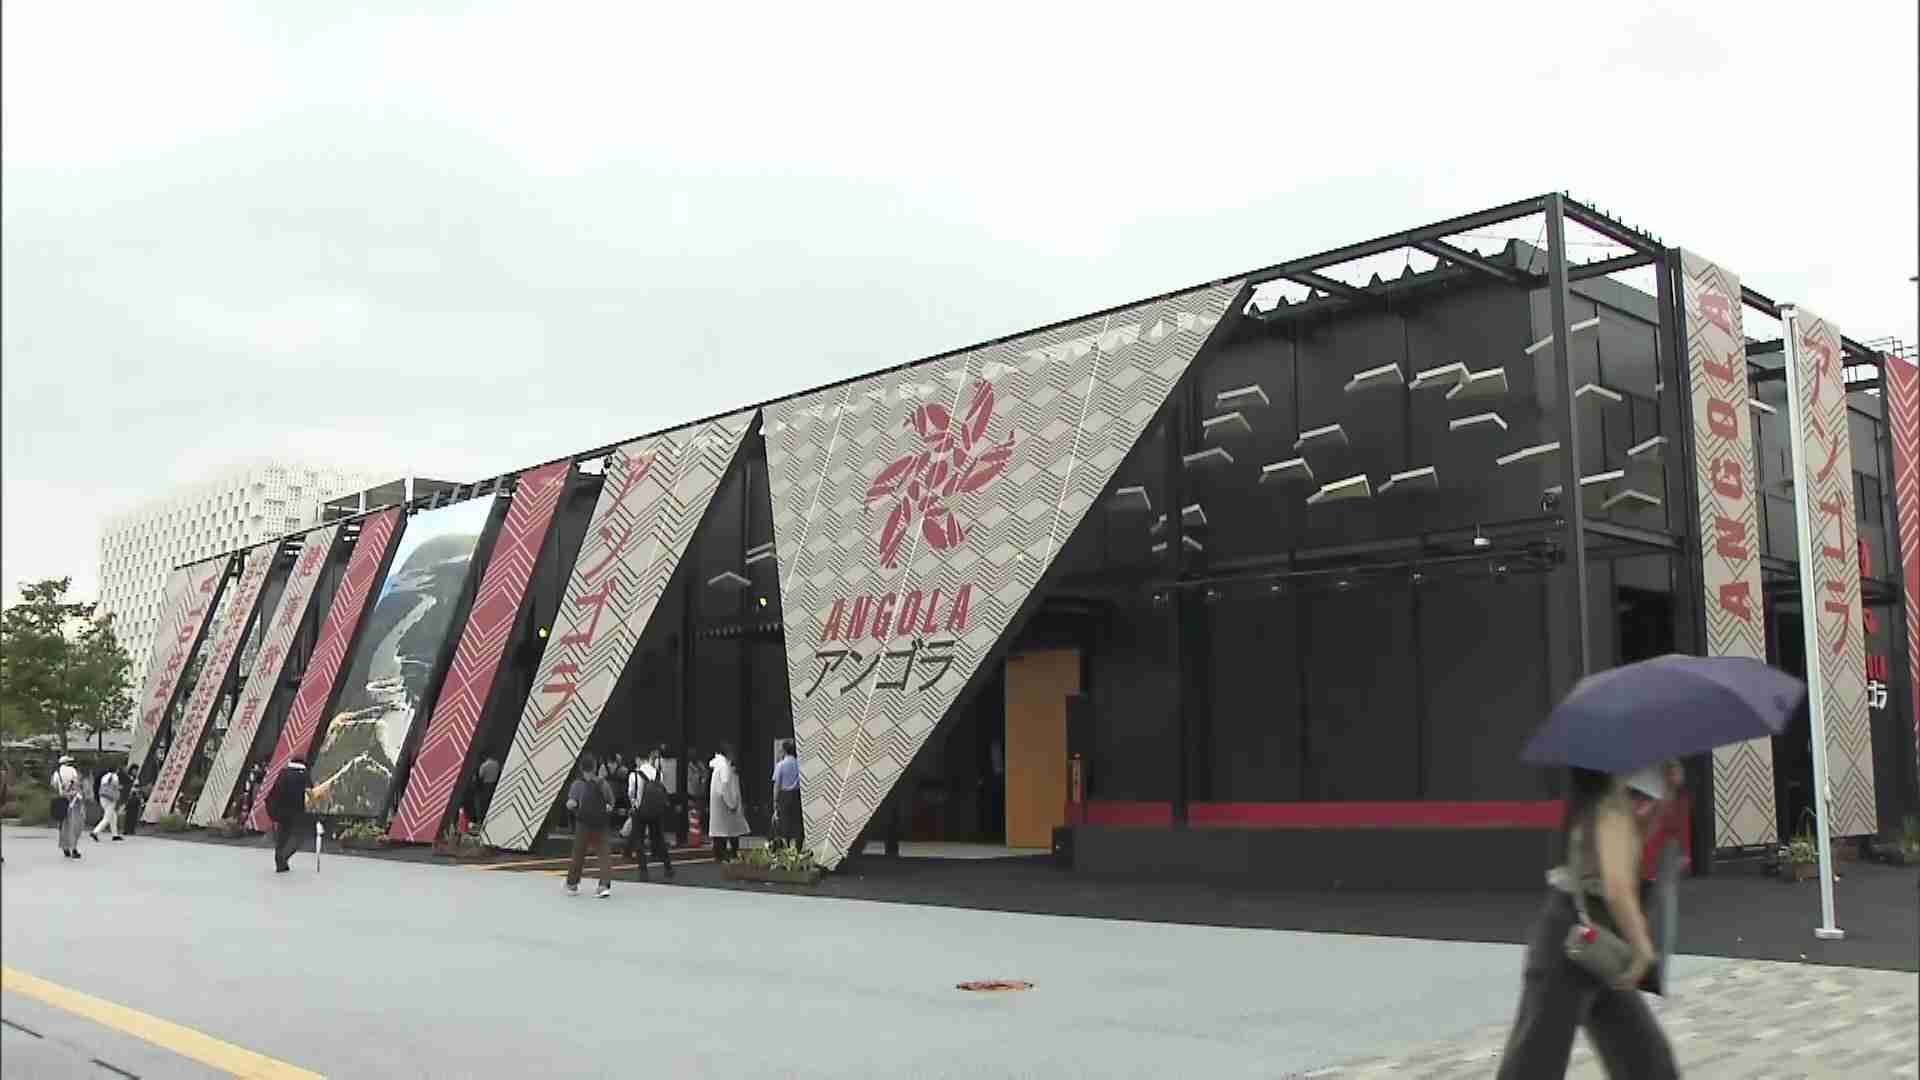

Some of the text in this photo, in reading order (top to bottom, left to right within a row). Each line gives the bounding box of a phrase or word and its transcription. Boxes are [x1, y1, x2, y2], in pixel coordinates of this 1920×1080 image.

[537, 457, 656, 728] アンゴラ
[1701, 292, 1751, 624] ANGOLA
[1802, 334, 1847, 655] アンゴラ
[806, 639, 955, 698] アンゴラ
[822, 584, 972, 641] ANGOLA
